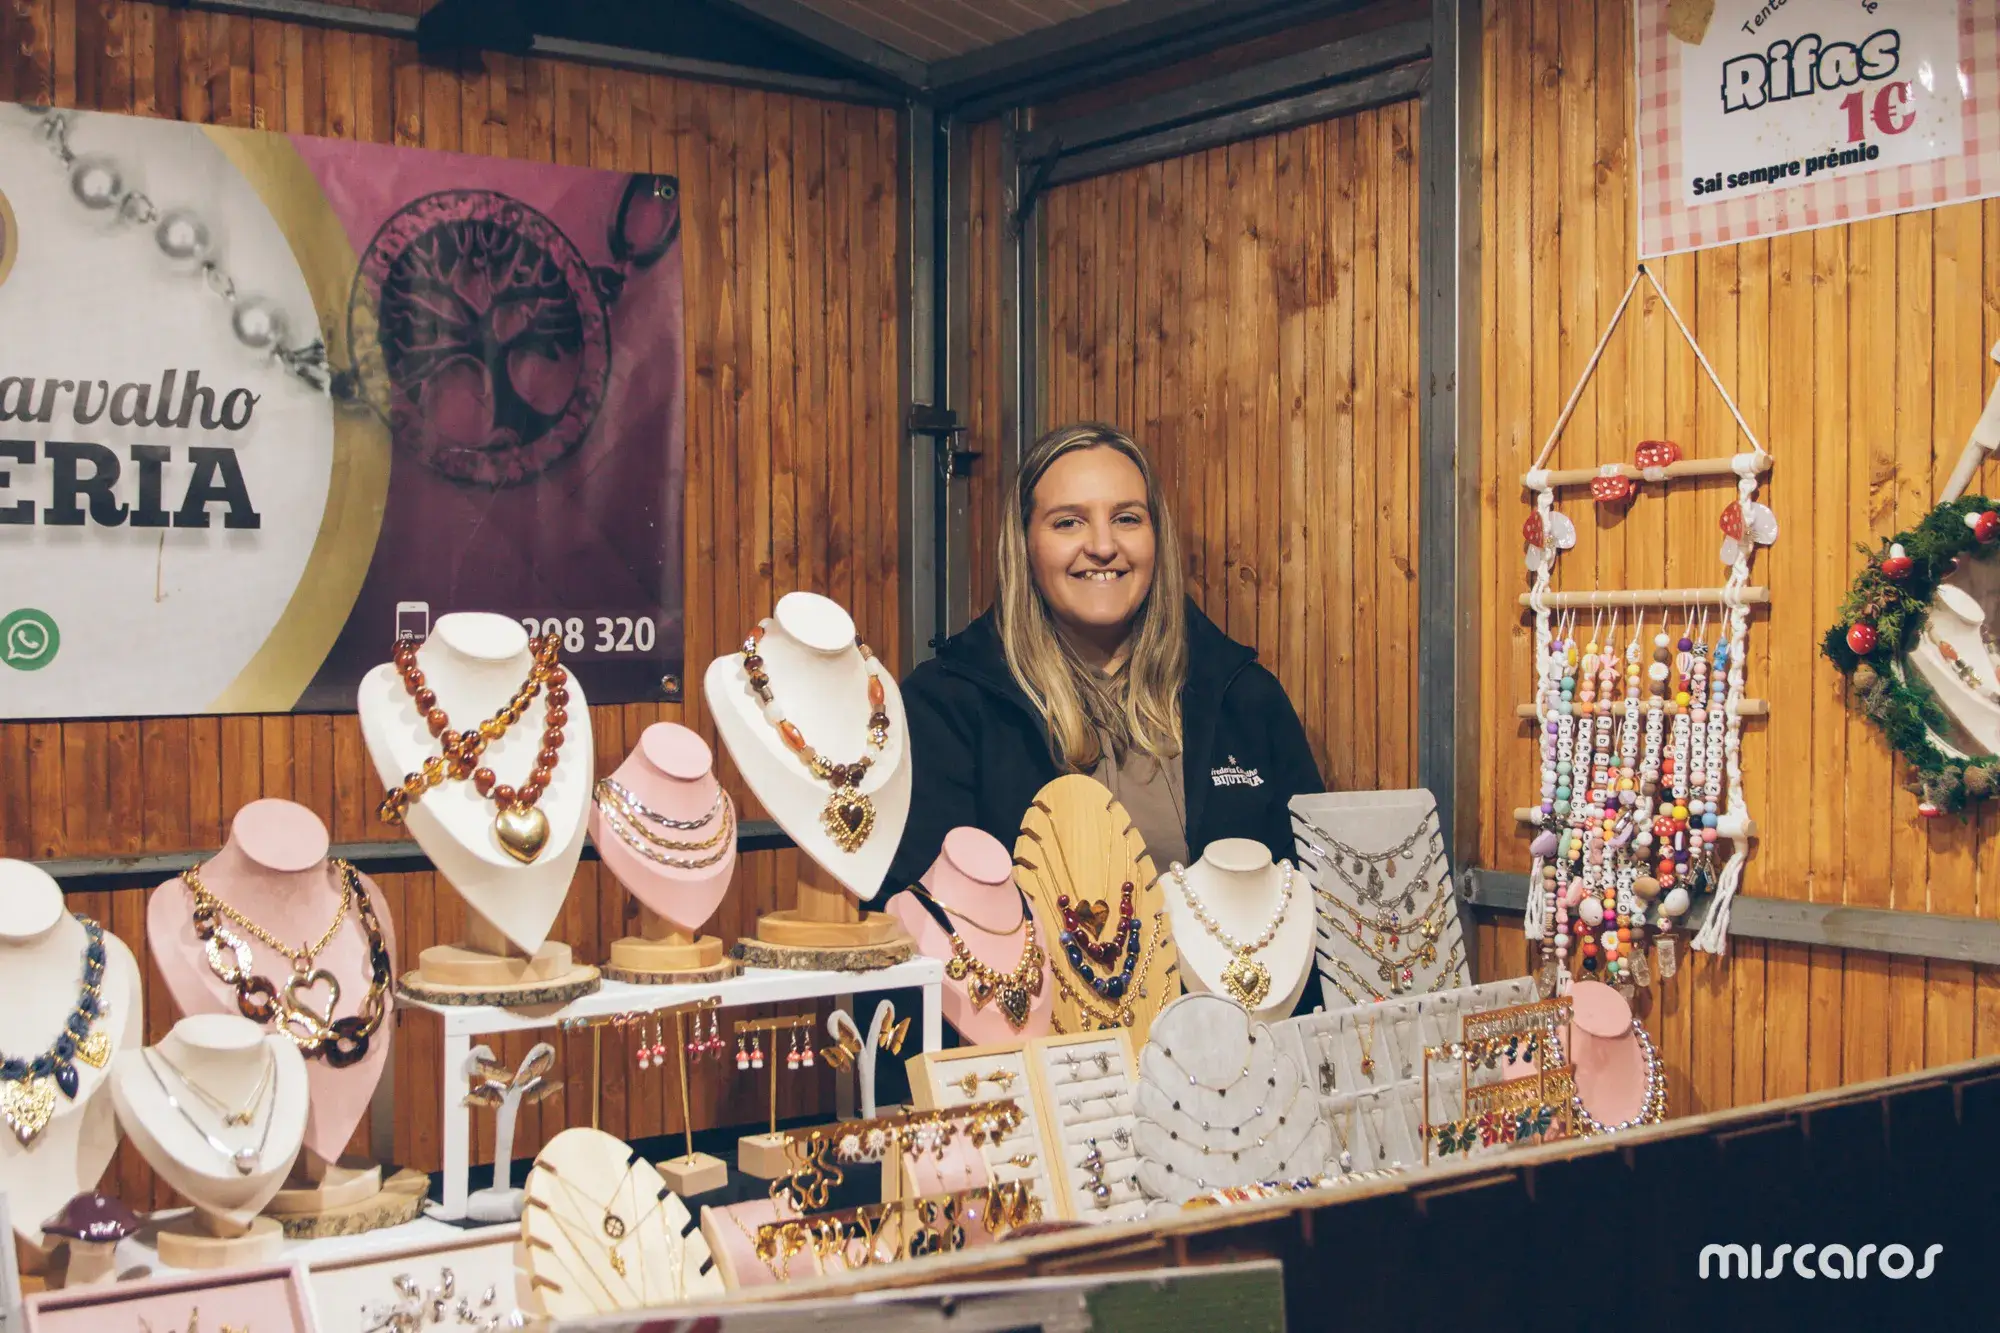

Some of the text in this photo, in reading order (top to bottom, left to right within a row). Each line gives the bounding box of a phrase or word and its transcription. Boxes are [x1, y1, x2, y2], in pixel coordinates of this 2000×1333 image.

[1721, 29, 1900, 114] Rifas
[1839, 80, 1917, 143] 1€
[1693, 142, 1880, 195] Sai sempre prémio
[594, 616, 656, 652] 320
[1674, 717, 1688, 796] VITORIA
[1706, 713, 1722, 792] BEATRIZ
